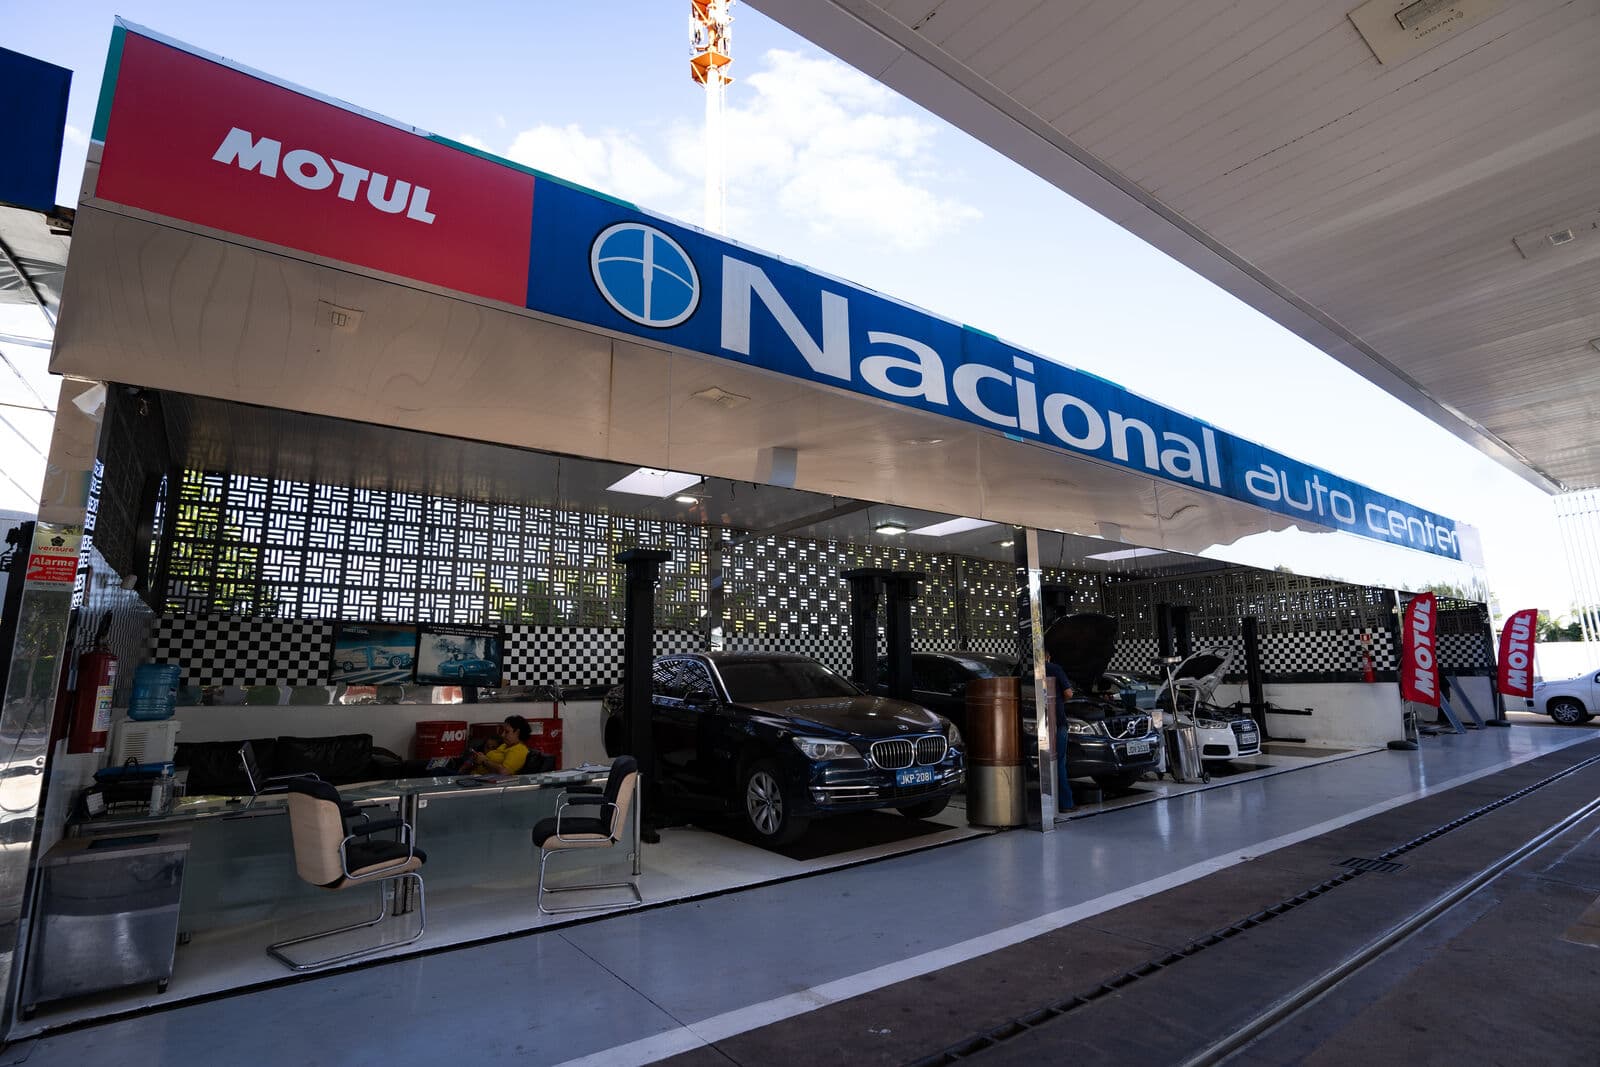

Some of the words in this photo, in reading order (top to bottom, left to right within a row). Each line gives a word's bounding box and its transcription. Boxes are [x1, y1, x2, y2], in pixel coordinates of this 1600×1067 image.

[212, 126, 436, 224] MOTUL
[721, 254, 1223, 489] Nacional
[1245, 463, 1356, 525] auto
[1365, 502, 1460, 554] center
[33, 557, 75, 566] Alarme
[1413, 599, 1435, 699] MOTUL
[1507, 614, 1532, 692] MOTUL
